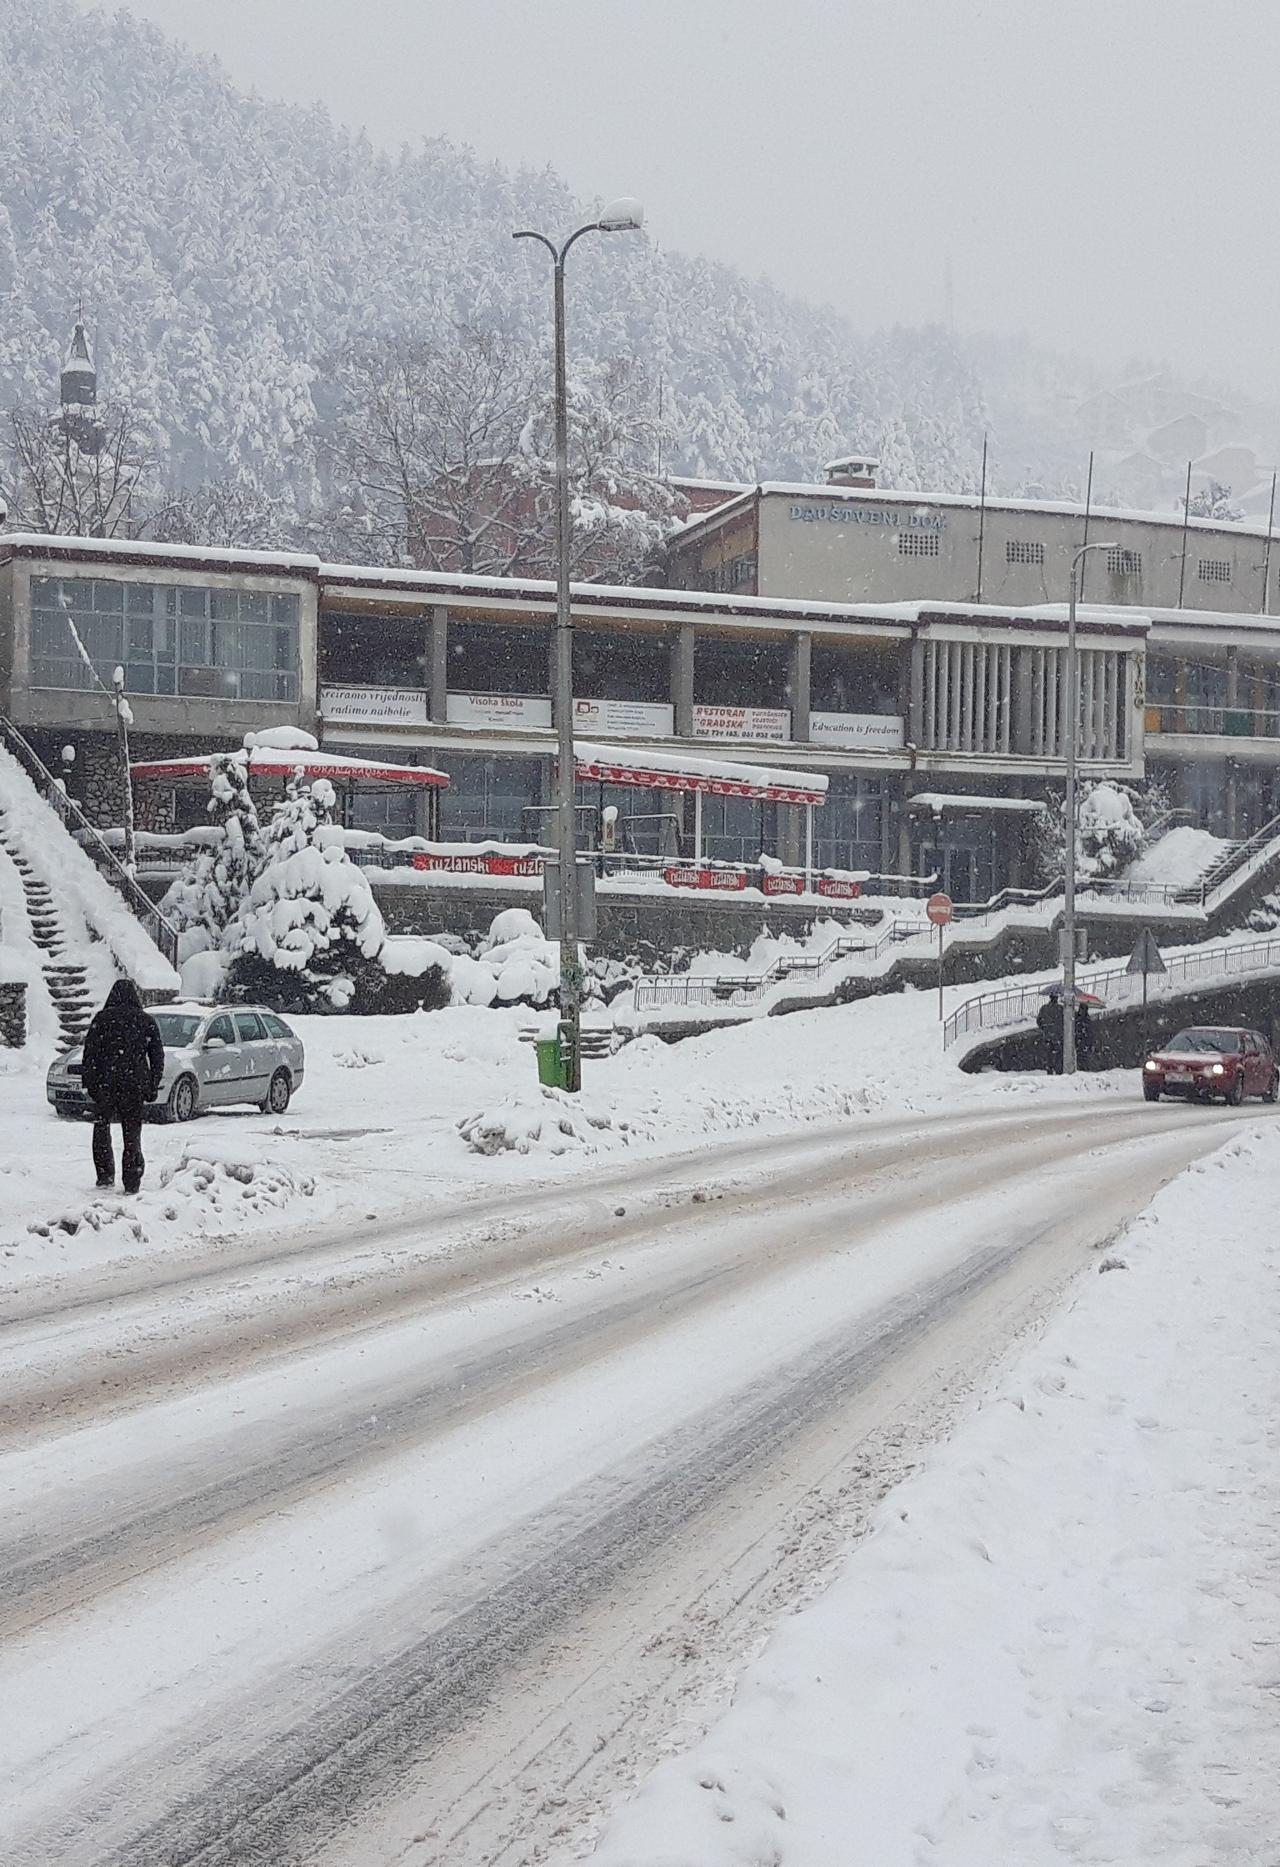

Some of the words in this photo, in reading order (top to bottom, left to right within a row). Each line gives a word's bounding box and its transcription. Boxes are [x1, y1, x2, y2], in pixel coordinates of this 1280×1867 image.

[469, 696, 498, 706] Visoka
[330, 705, 368, 715] radimo
[696, 707, 746, 718] RESTORAN
[812, 722, 854, 733] Education
[856, 724, 863, 733] is
[864, 725, 900, 736] freedom
